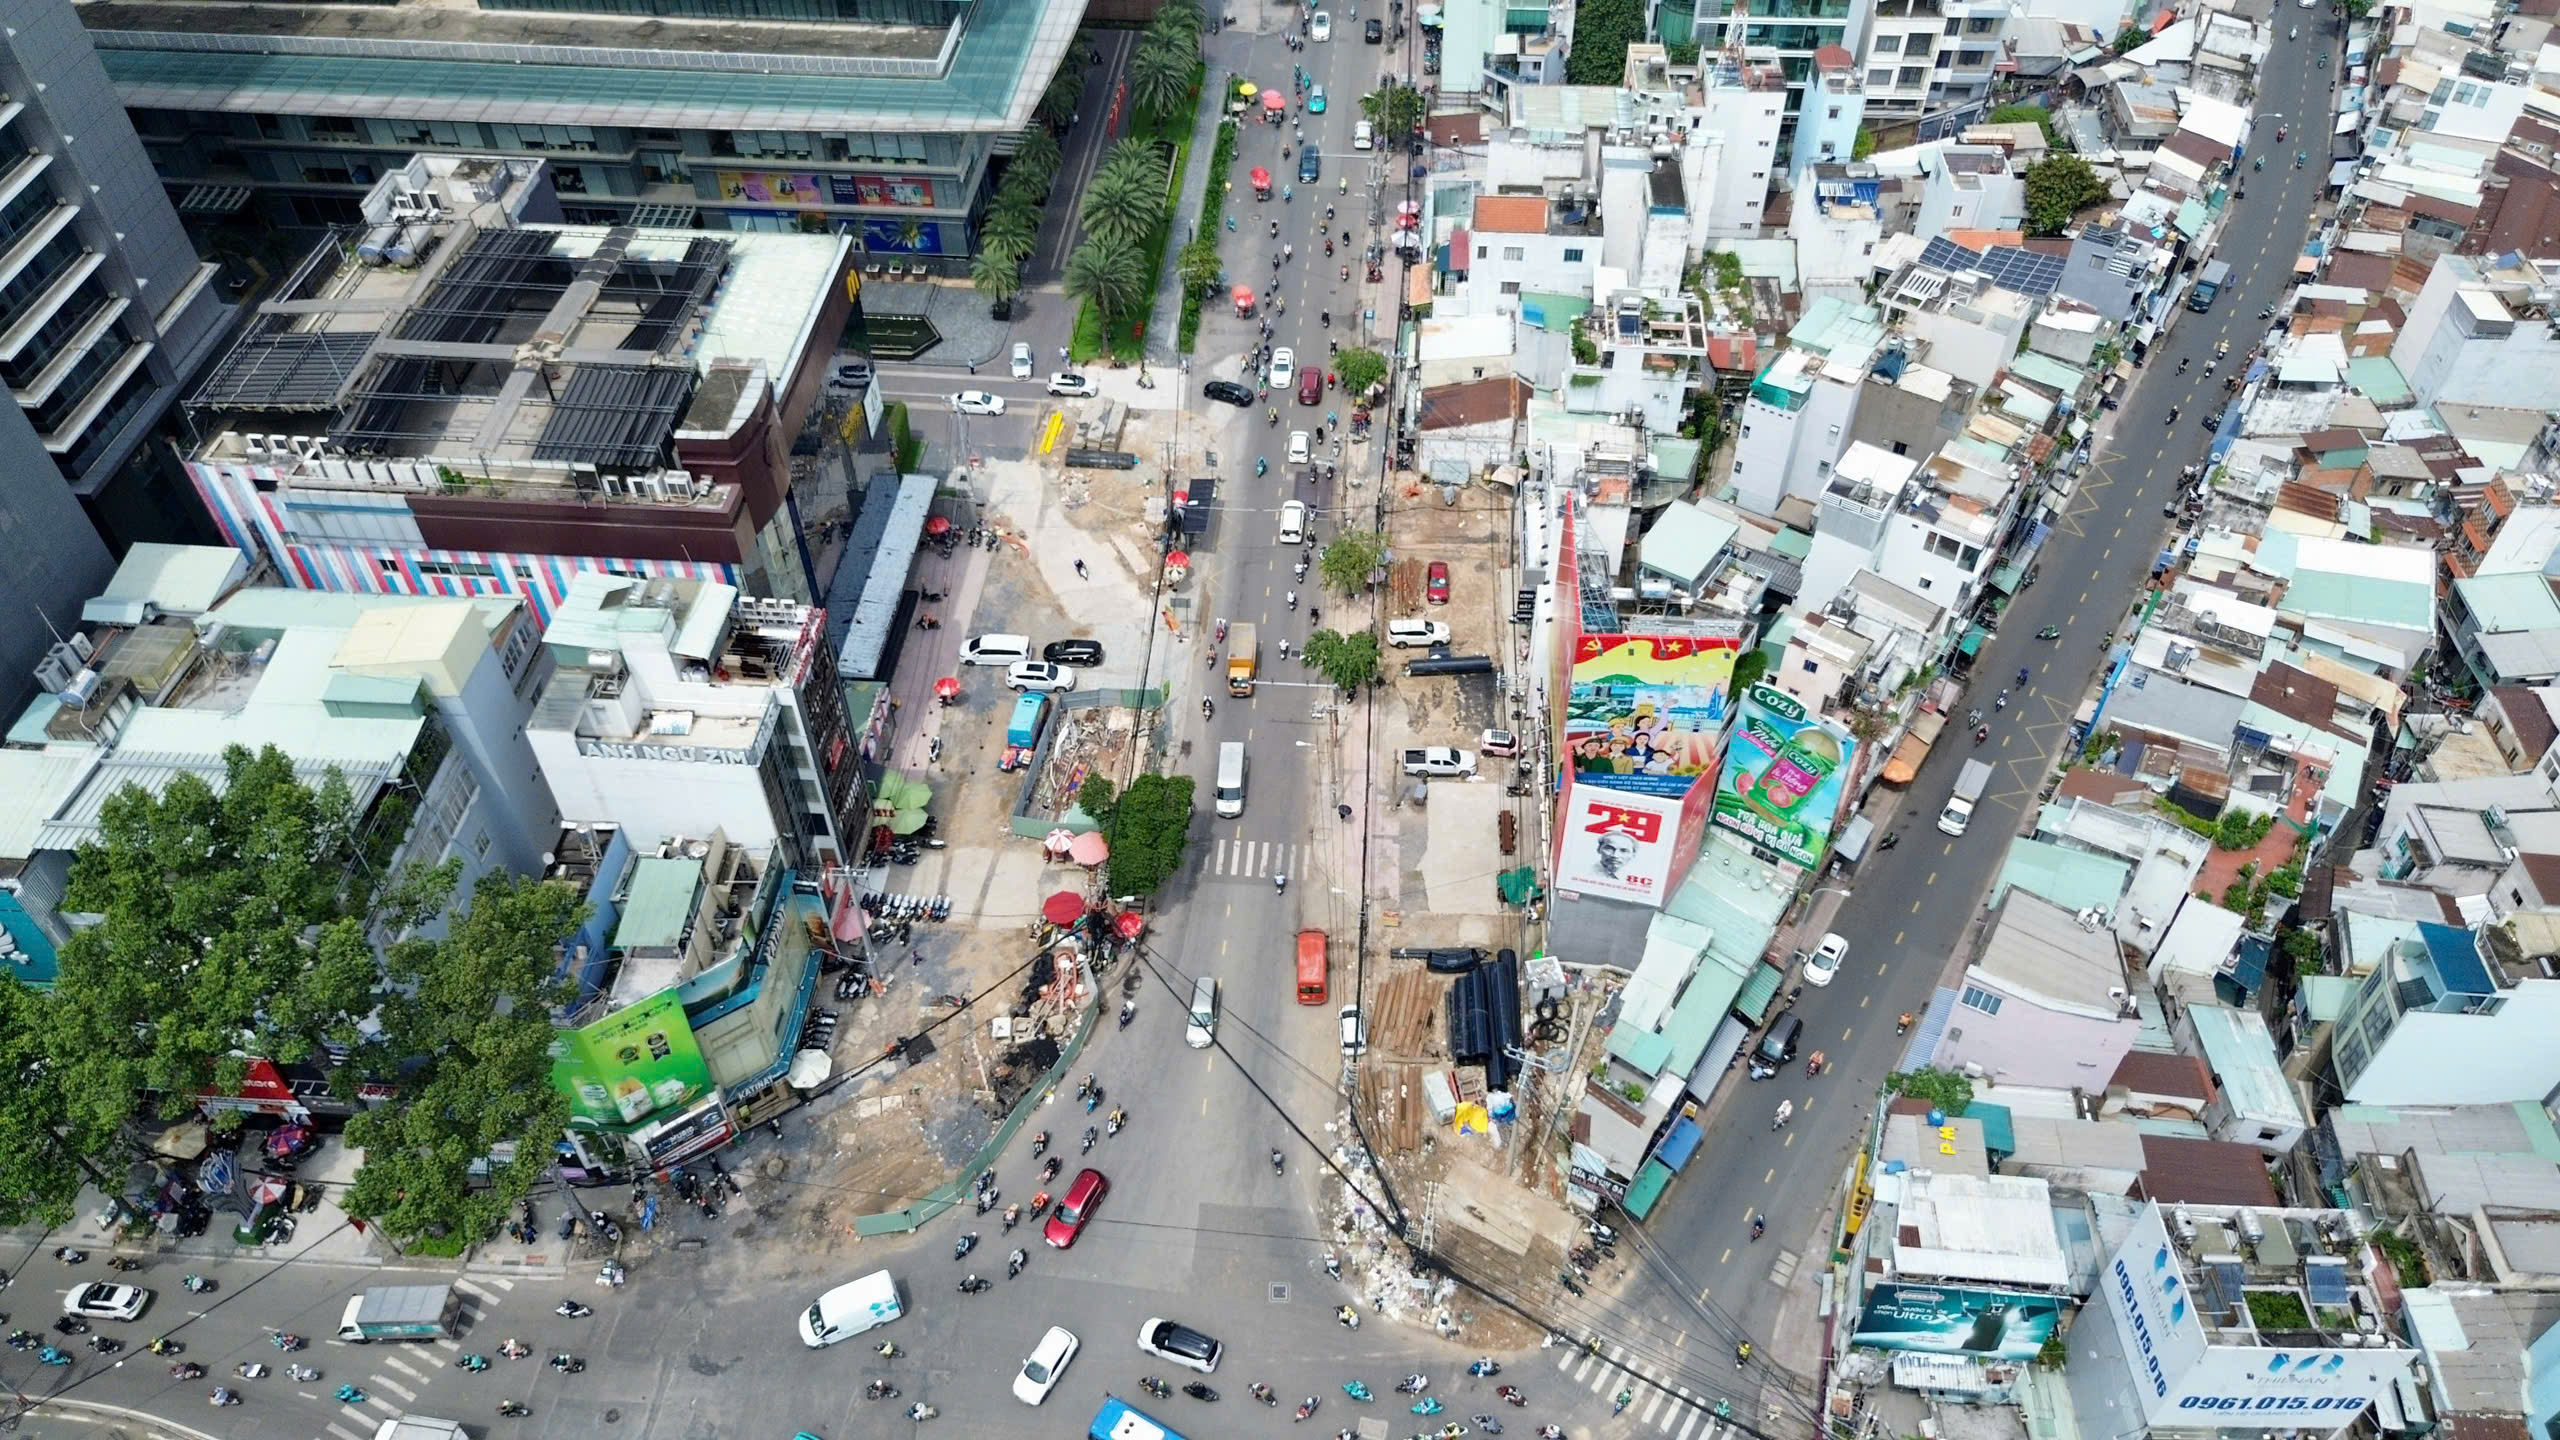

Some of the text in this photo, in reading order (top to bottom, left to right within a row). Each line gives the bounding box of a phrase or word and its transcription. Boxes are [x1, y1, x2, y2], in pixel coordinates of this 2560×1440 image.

[1754, 689, 1803, 718] Cozy
[586, 743, 638, 759] ANH
[705, 749, 748, 765] ZIM
[1737, 808, 1758, 825] TRÀ
[1758, 819, 1779, 834] HOA
[1717, 813, 1740, 829] NGON
[1790, 847, 1814, 864] NGON
[738, 1075, 774, 1100] KATINAT
[2115, 1258, 2167, 1399] 0961.015.016
[2178, 1395, 2367, 1410] 0961.015.016
